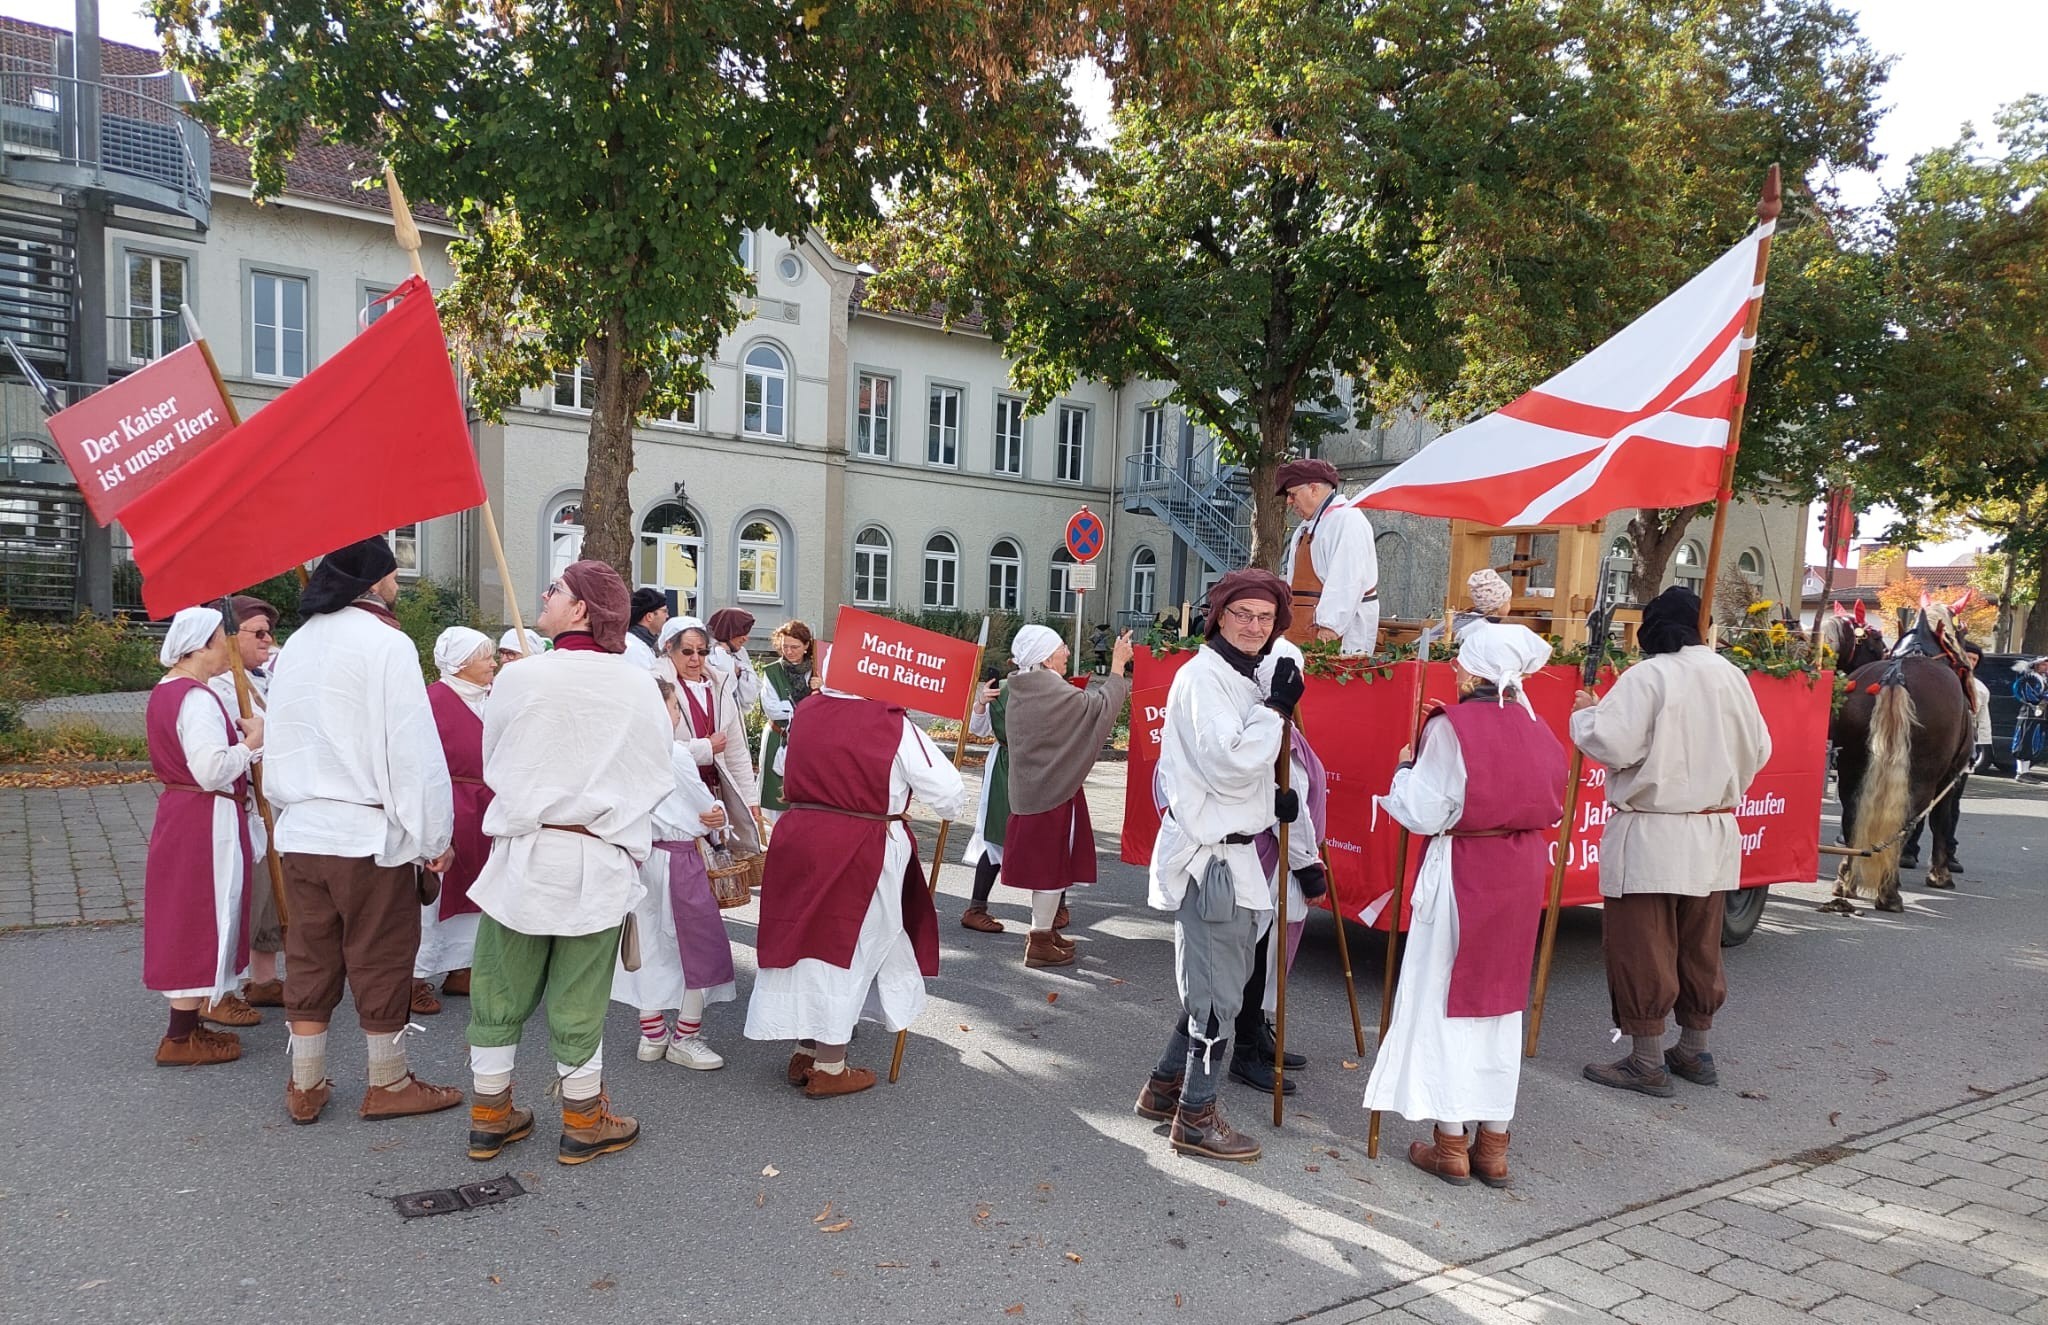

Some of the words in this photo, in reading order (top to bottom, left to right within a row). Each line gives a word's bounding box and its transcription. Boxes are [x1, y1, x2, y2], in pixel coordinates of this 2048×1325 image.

[80, 438, 121, 463] Der
[118, 396, 178, 442] Kaiser
[96, 462, 126, 491] ist
[124, 432, 175, 475] unser
[173, 408, 220, 443] Herr.
[861, 632, 914, 662] Macht
[916, 652, 946, 670] nur
[857, 656, 889, 679] den
[893, 664, 946, 693] Räten!
[1579, 801, 1617, 832] Jah
[1579, 839, 1602, 870] Ja
